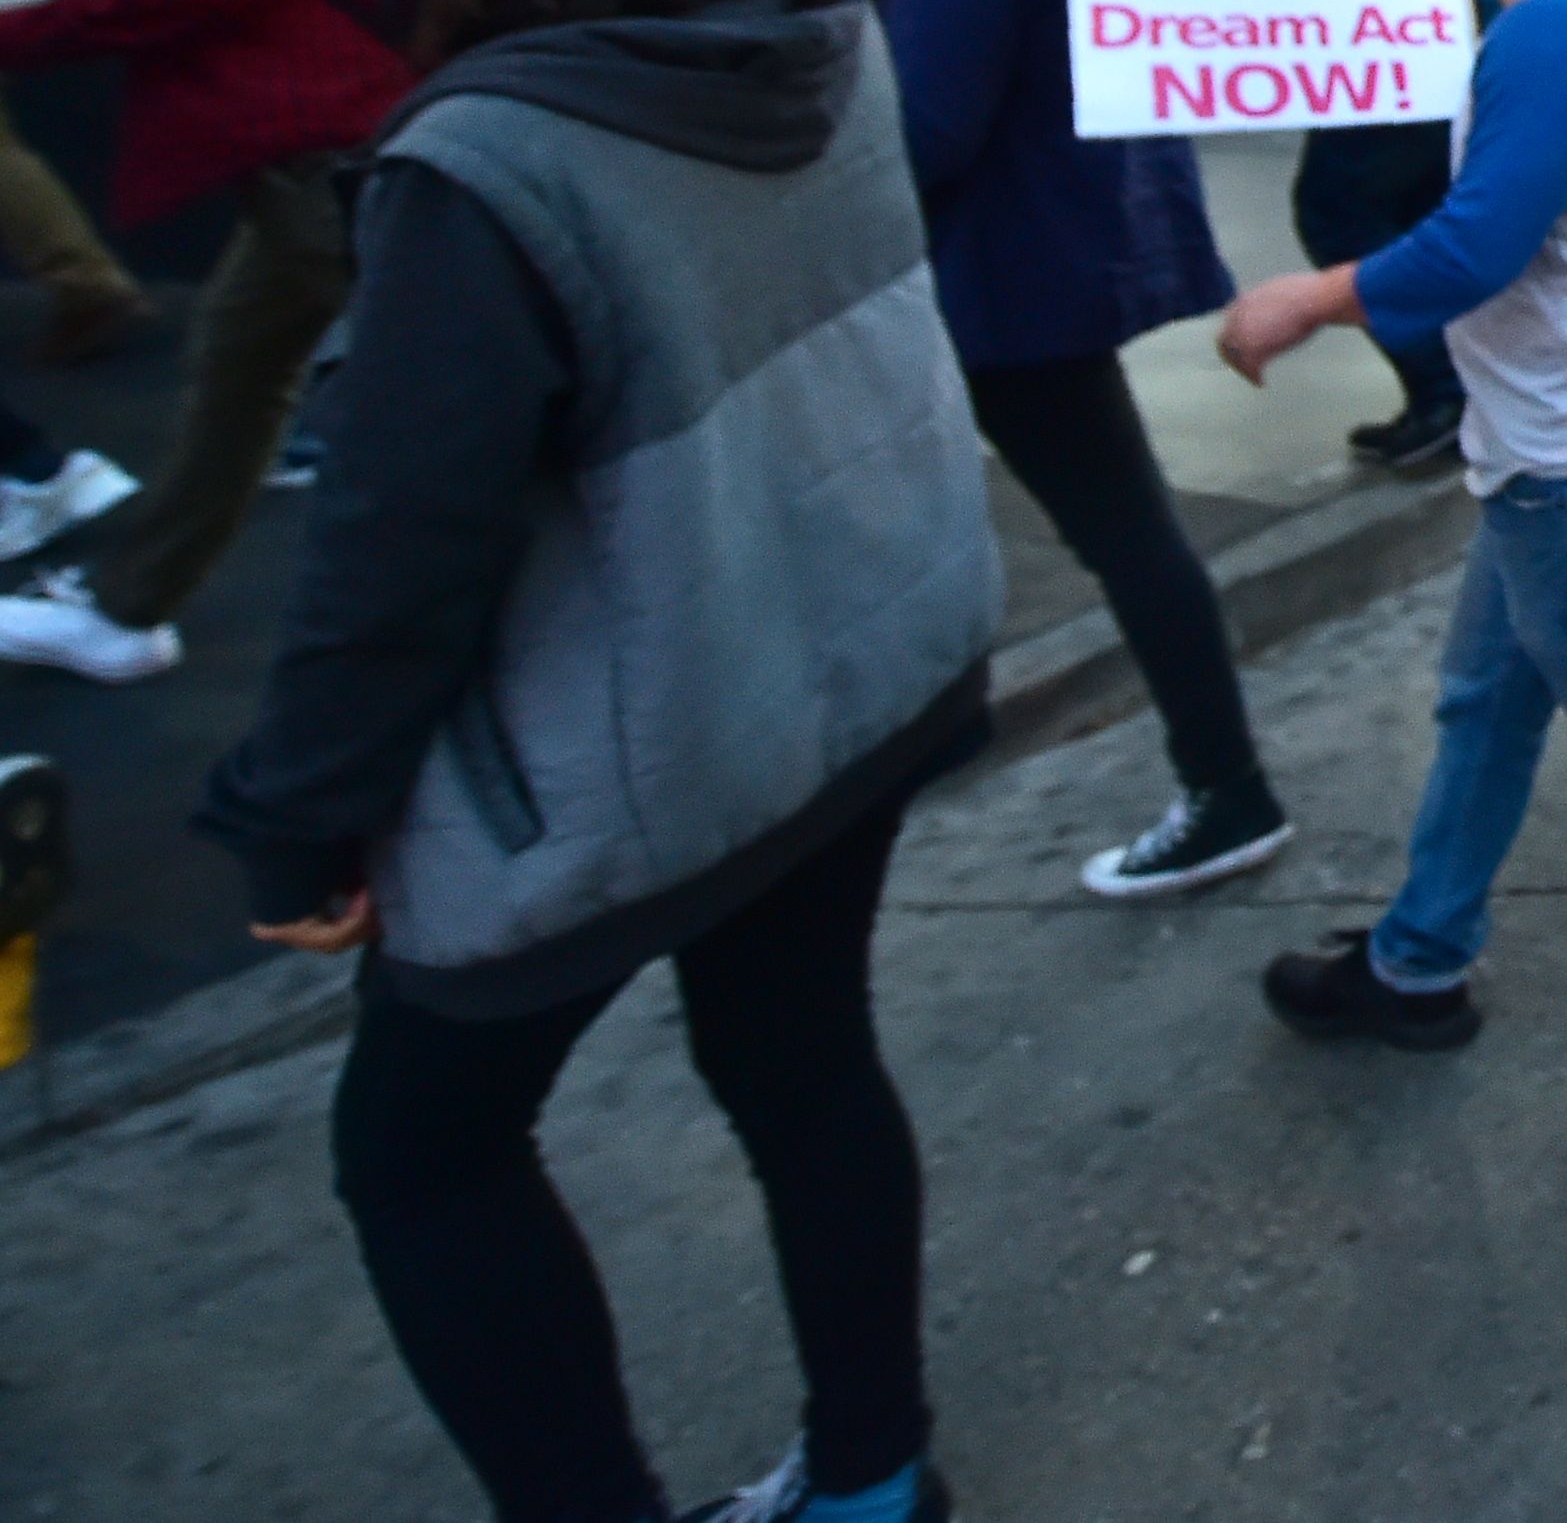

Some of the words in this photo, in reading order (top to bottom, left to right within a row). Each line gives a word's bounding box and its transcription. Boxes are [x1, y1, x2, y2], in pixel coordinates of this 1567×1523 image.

[1090, 2, 1332, 50] Dream
[1350, 4, 1455, 47] Act
[1151, 60, 1414, 121] NOW!
